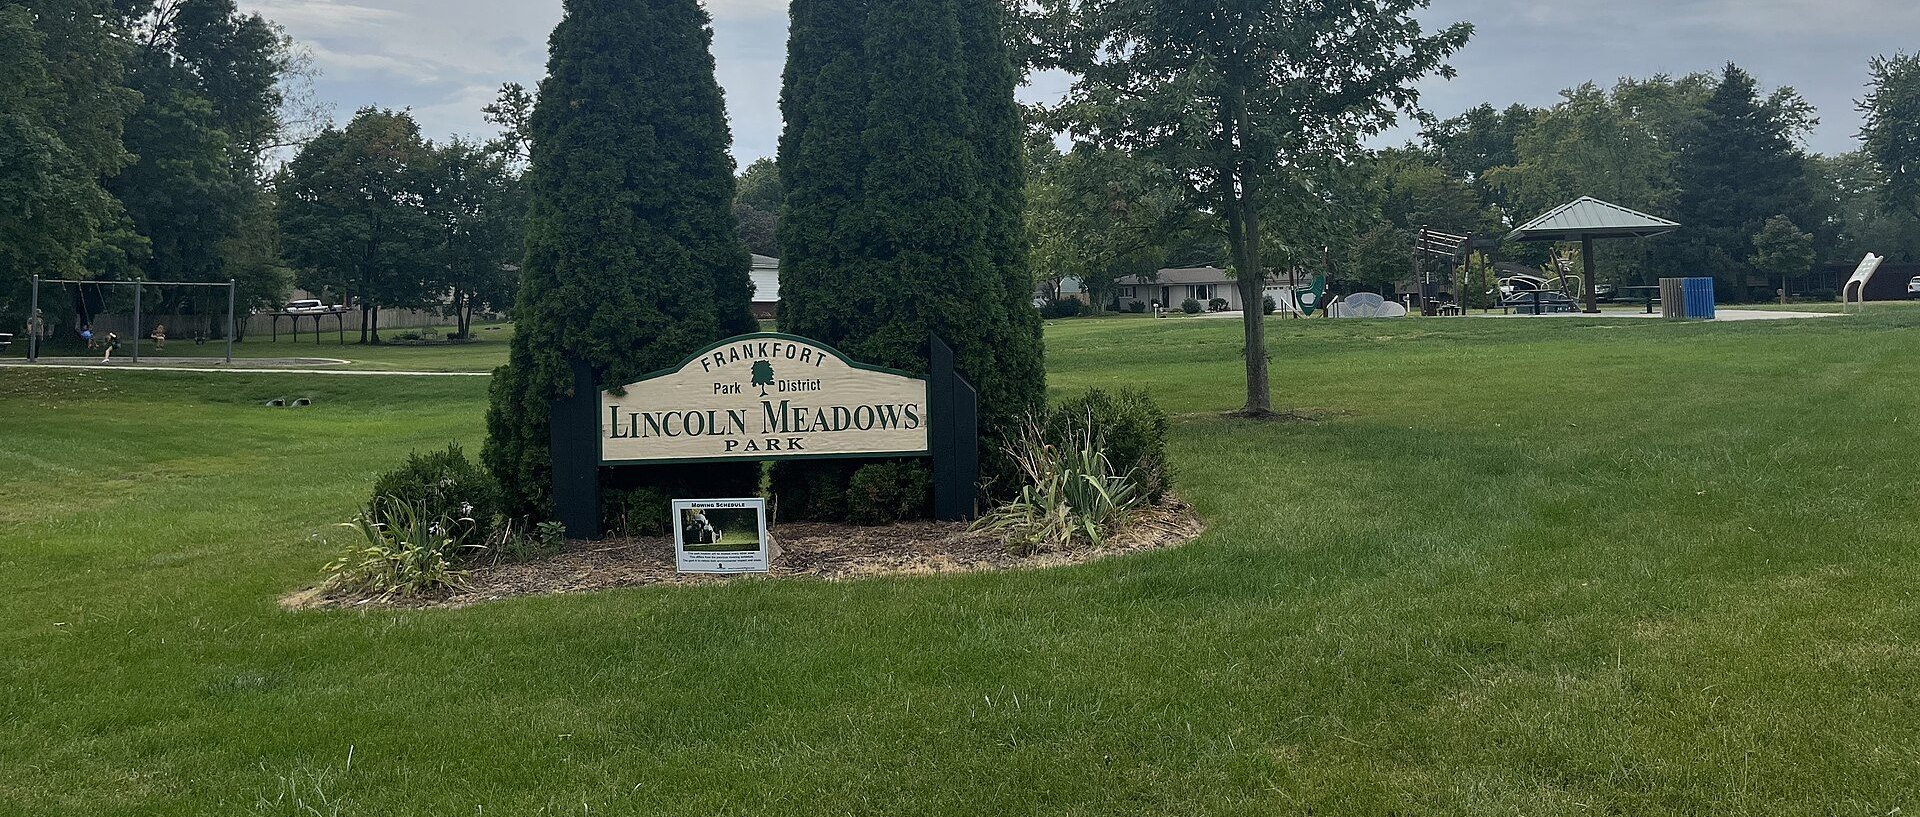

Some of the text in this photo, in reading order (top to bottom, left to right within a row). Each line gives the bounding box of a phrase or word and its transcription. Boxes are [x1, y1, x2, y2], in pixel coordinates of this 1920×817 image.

[700, 342, 827, 373] FRANKFORT
[713, 378, 822, 395] Park District
[609, 399, 920, 439] LINCOLN MEADOWS
[724, 437, 805, 452] PARK
